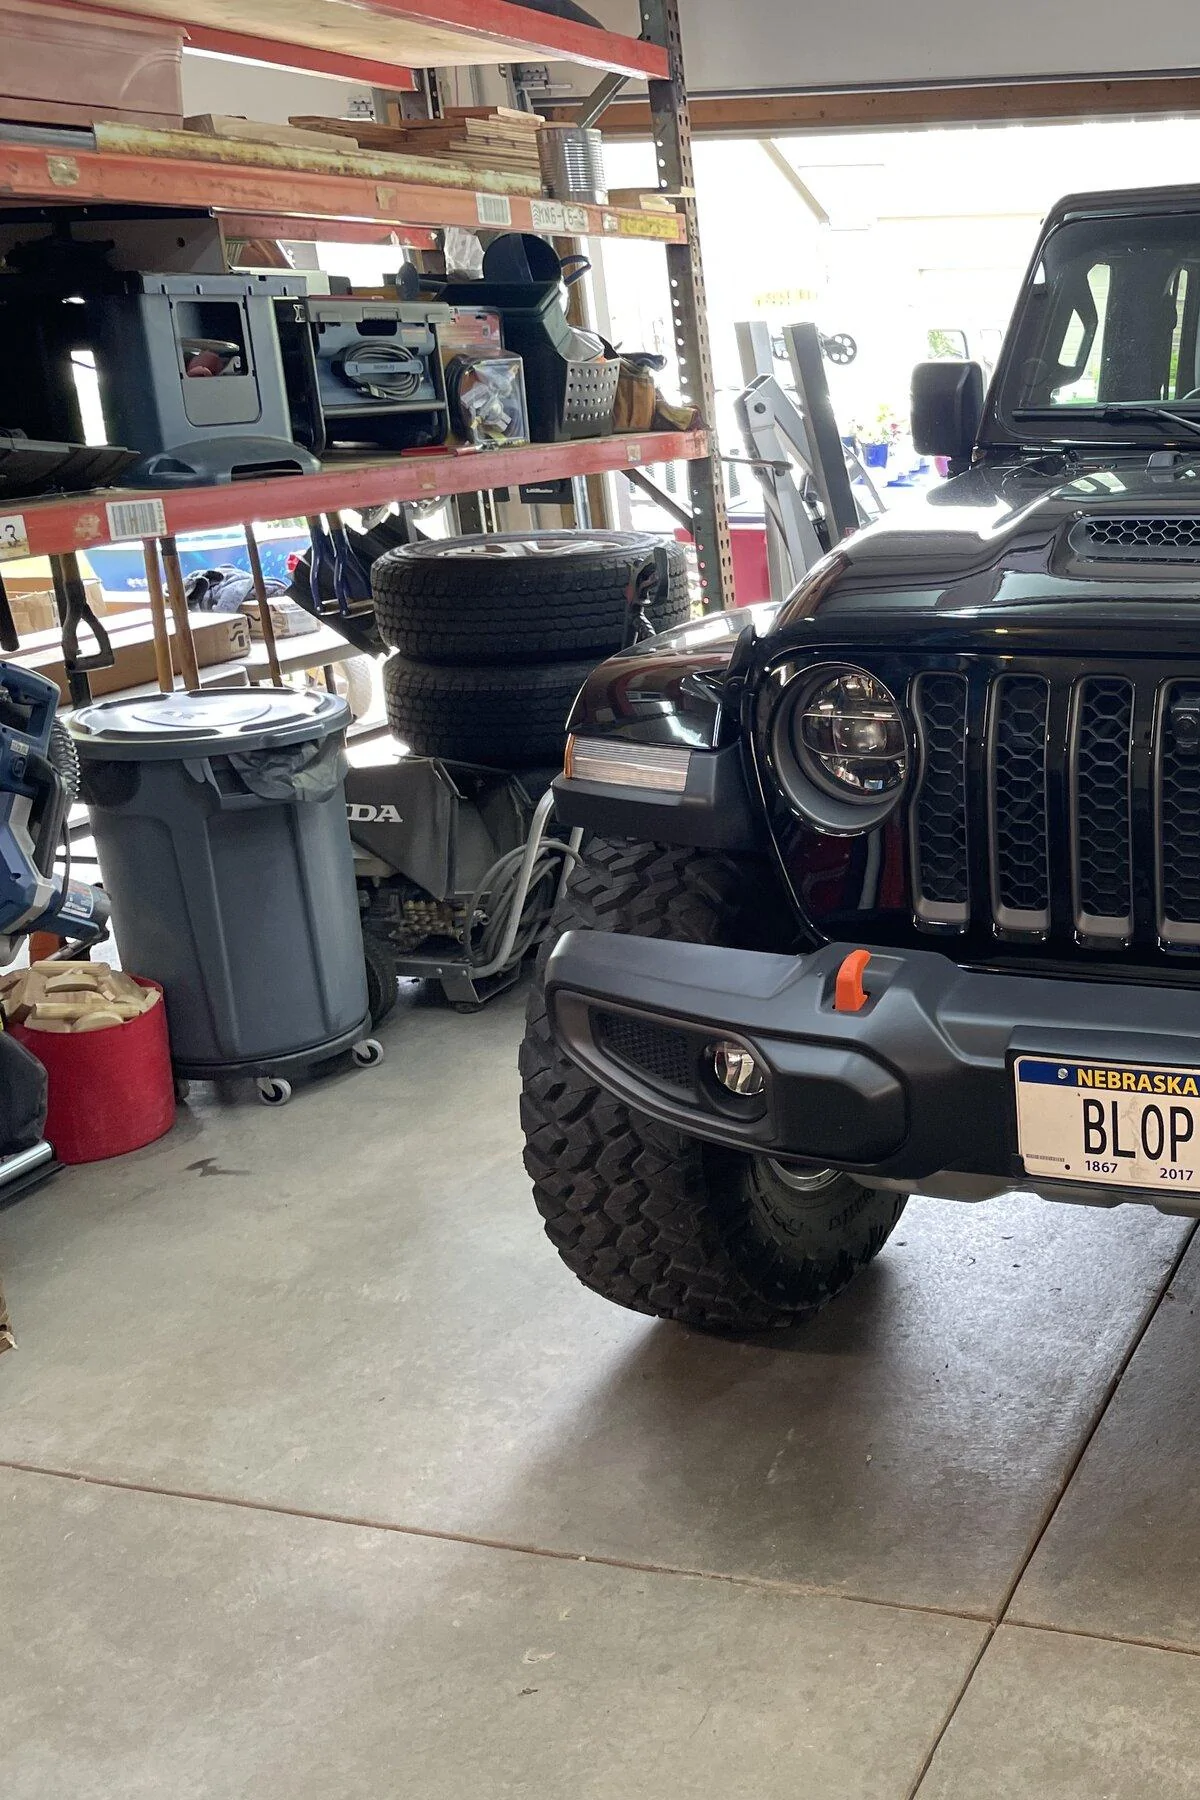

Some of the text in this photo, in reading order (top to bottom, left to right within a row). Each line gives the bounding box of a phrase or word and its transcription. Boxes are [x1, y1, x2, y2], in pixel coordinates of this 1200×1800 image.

[346, 803, 403, 823] DA
[1077, 1068, 1199, 1096] NEBRASKA
[1082, 1098, 1194, 1162] BLOP
[1085, 1160, 1193, 1181] 1867 2017
